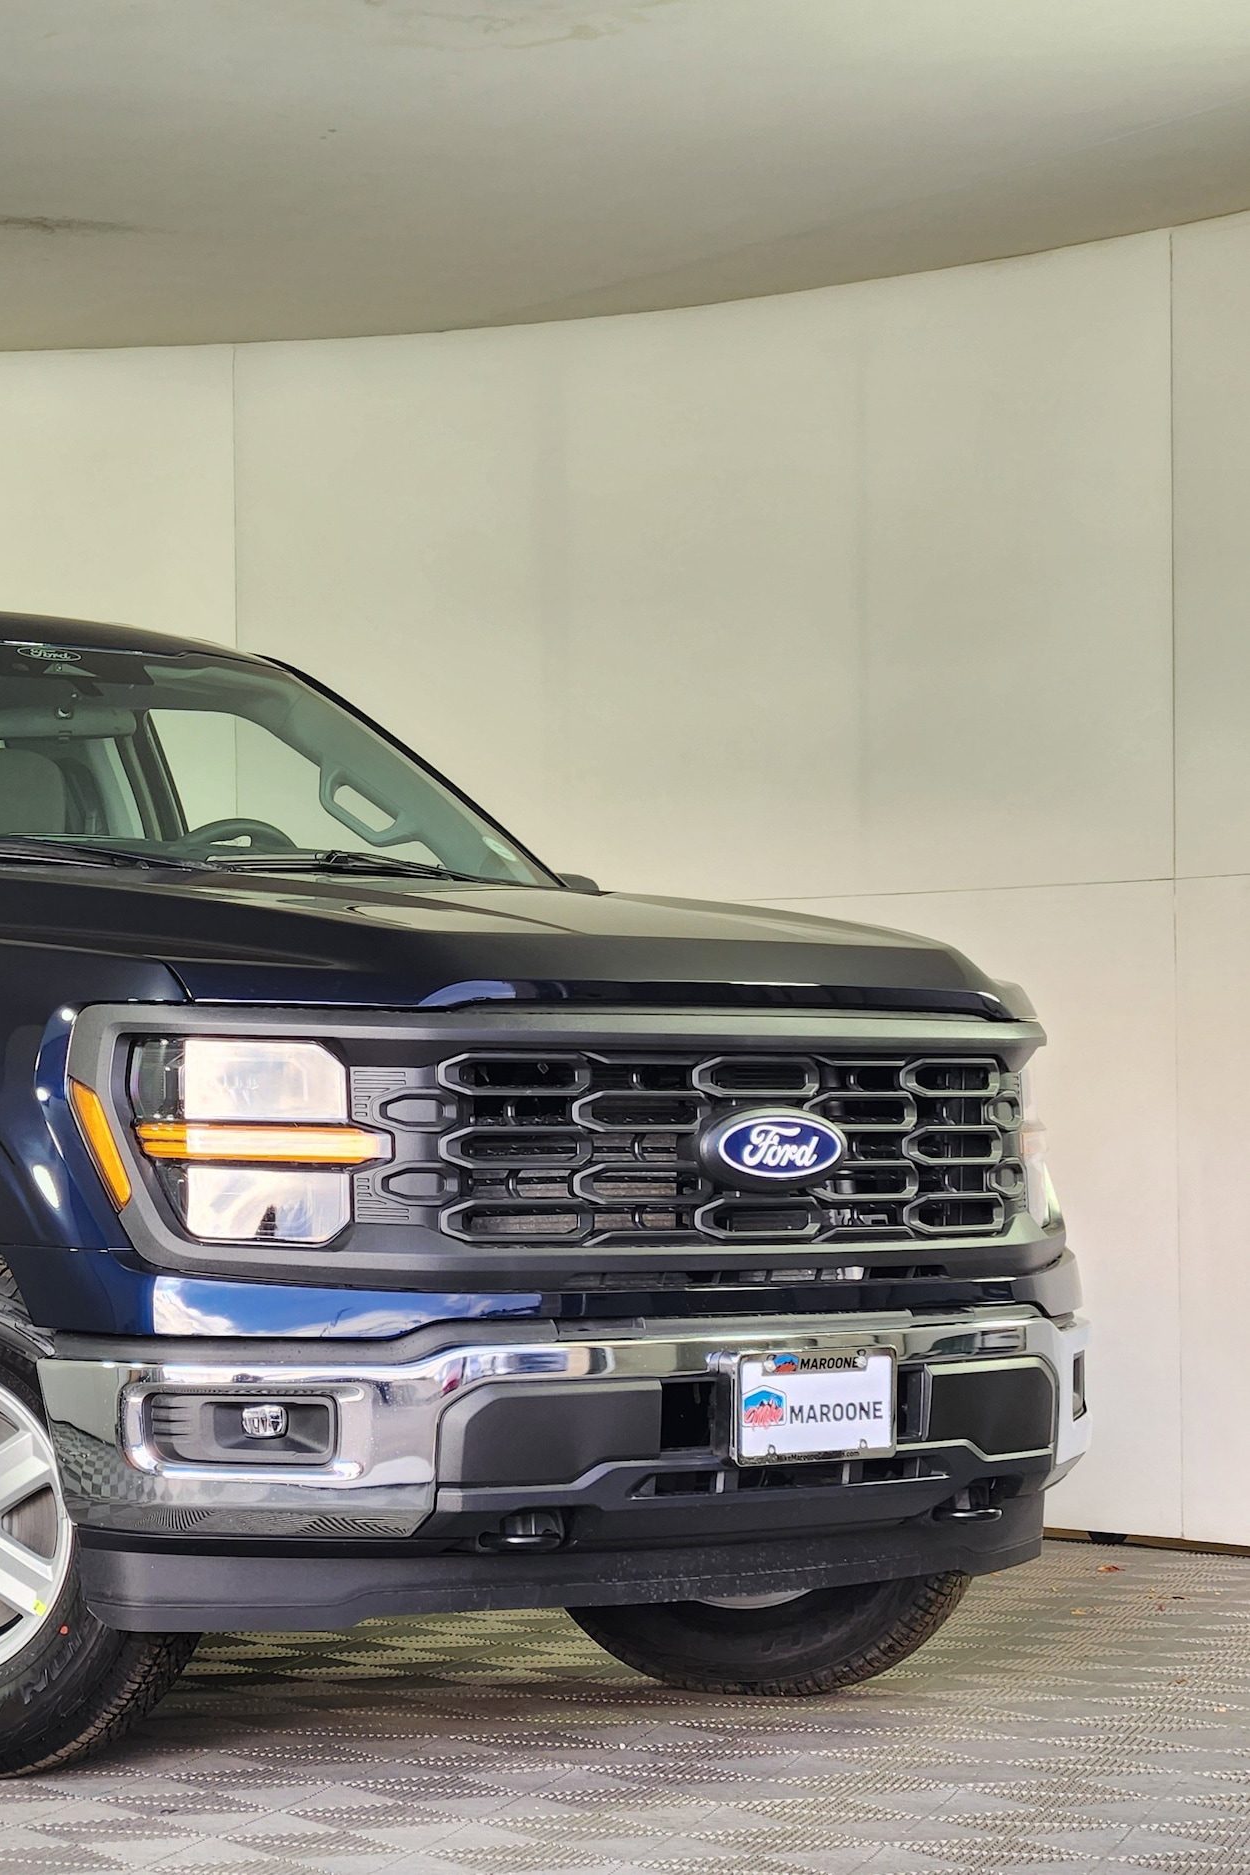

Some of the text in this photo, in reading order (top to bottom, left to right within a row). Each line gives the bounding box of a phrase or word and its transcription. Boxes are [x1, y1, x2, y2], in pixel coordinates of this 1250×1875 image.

[30, 647, 72, 660] Ford
[742, 1124, 820, 1168] Ford
[799, 1356, 860, 1370] MAROONE
[789, 1401, 884, 1425] MAROONE
